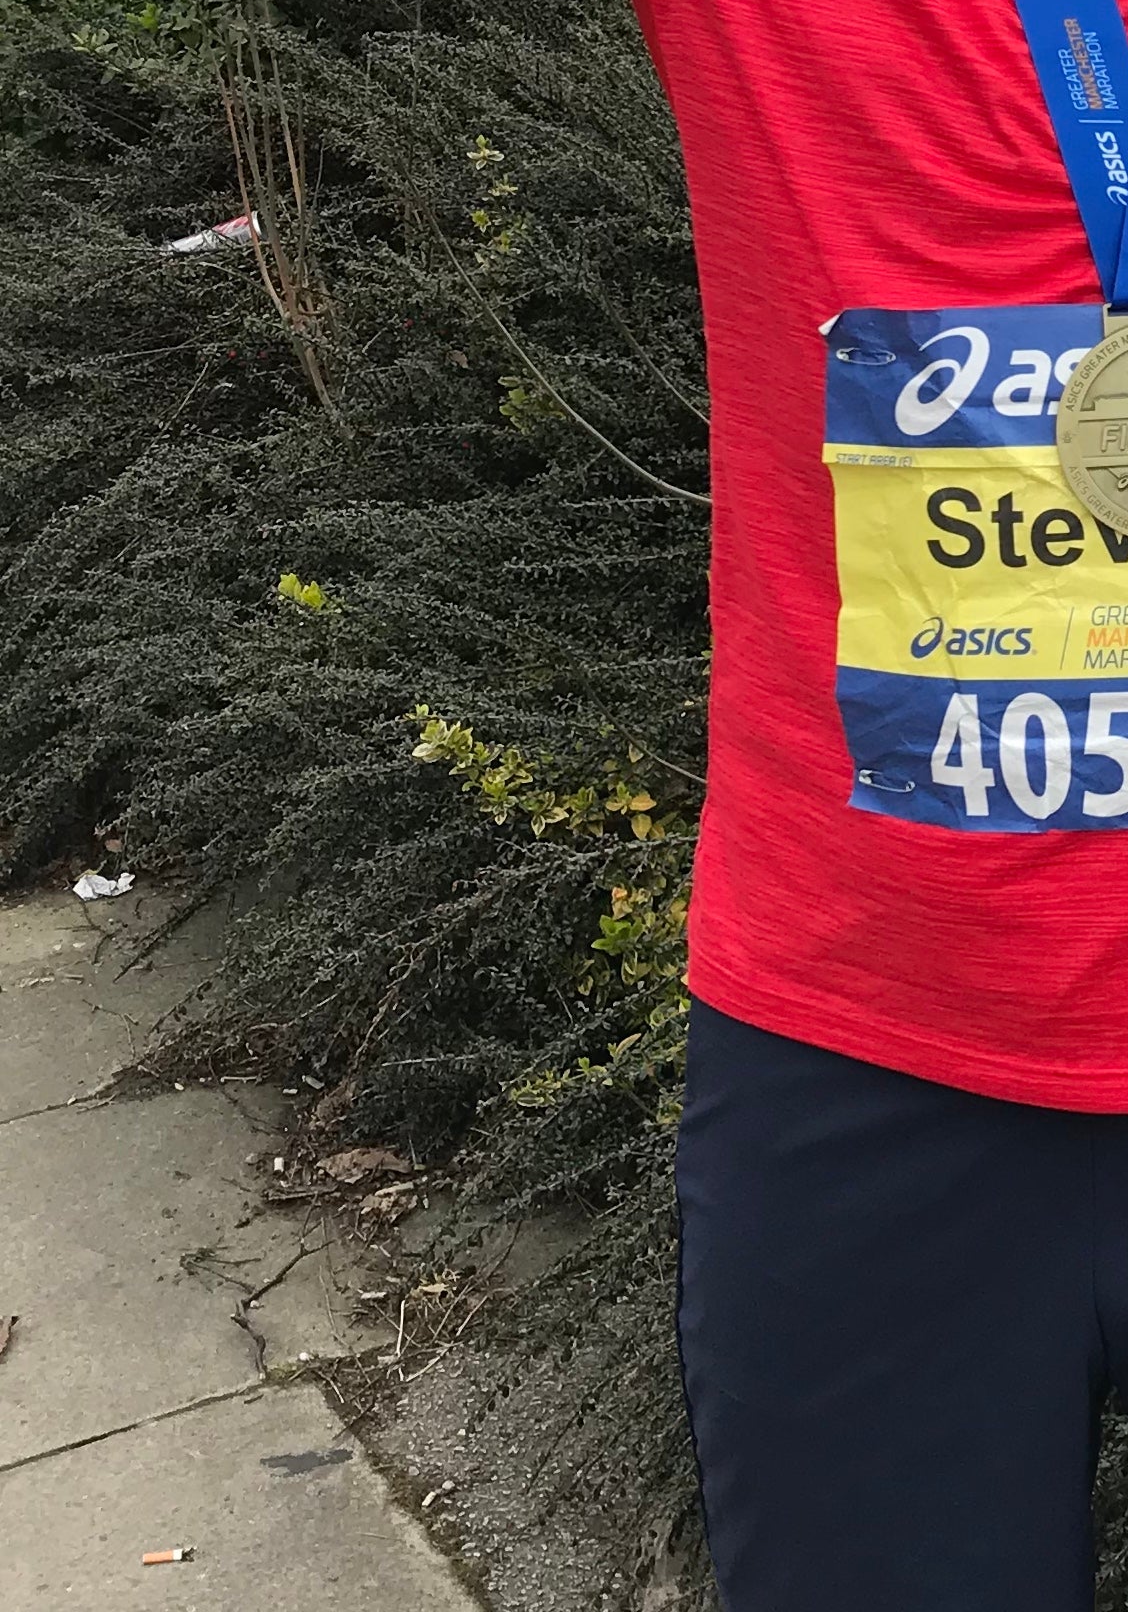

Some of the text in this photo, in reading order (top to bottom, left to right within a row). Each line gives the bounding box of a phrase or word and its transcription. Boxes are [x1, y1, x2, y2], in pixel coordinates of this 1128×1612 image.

[1058, 48, 1089, 111] GREATER
[1064, 17, 1104, 111] MANCHESTER
[1083, 31, 1119, 110] MARATHON
[1095, 131, 1128, 184] asics
[1065, 380, 1084, 412] ASICS
[1080, 340, 1121, 380] GREATER
[1068, 466, 1089, 495] ASICS
[945, 627, 1033, 656] asics
